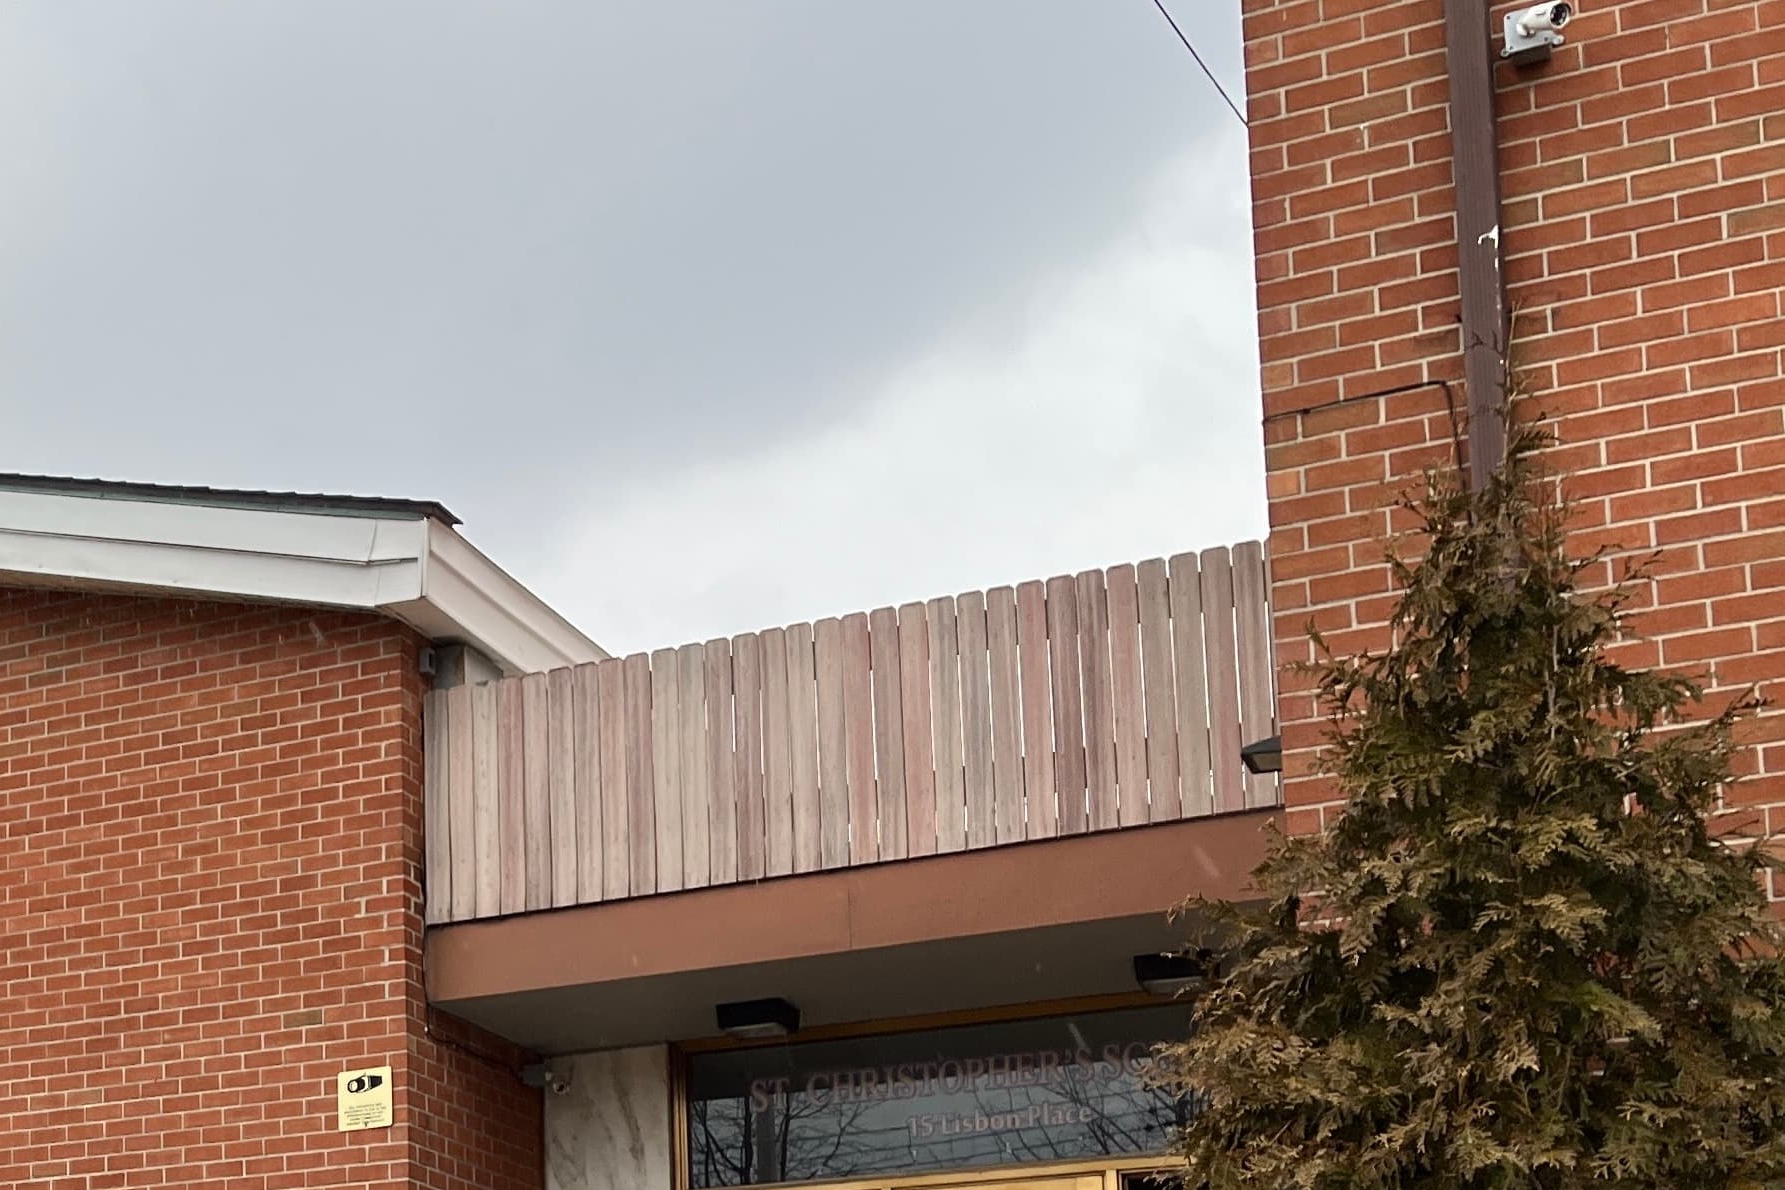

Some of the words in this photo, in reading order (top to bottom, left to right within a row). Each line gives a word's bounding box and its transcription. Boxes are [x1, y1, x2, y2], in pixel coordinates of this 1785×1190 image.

[908, 1115, 935, 1138] 15
[941, 1109, 1022, 1136] Lisbon
[1027, 1102, 1094, 1127] Place
